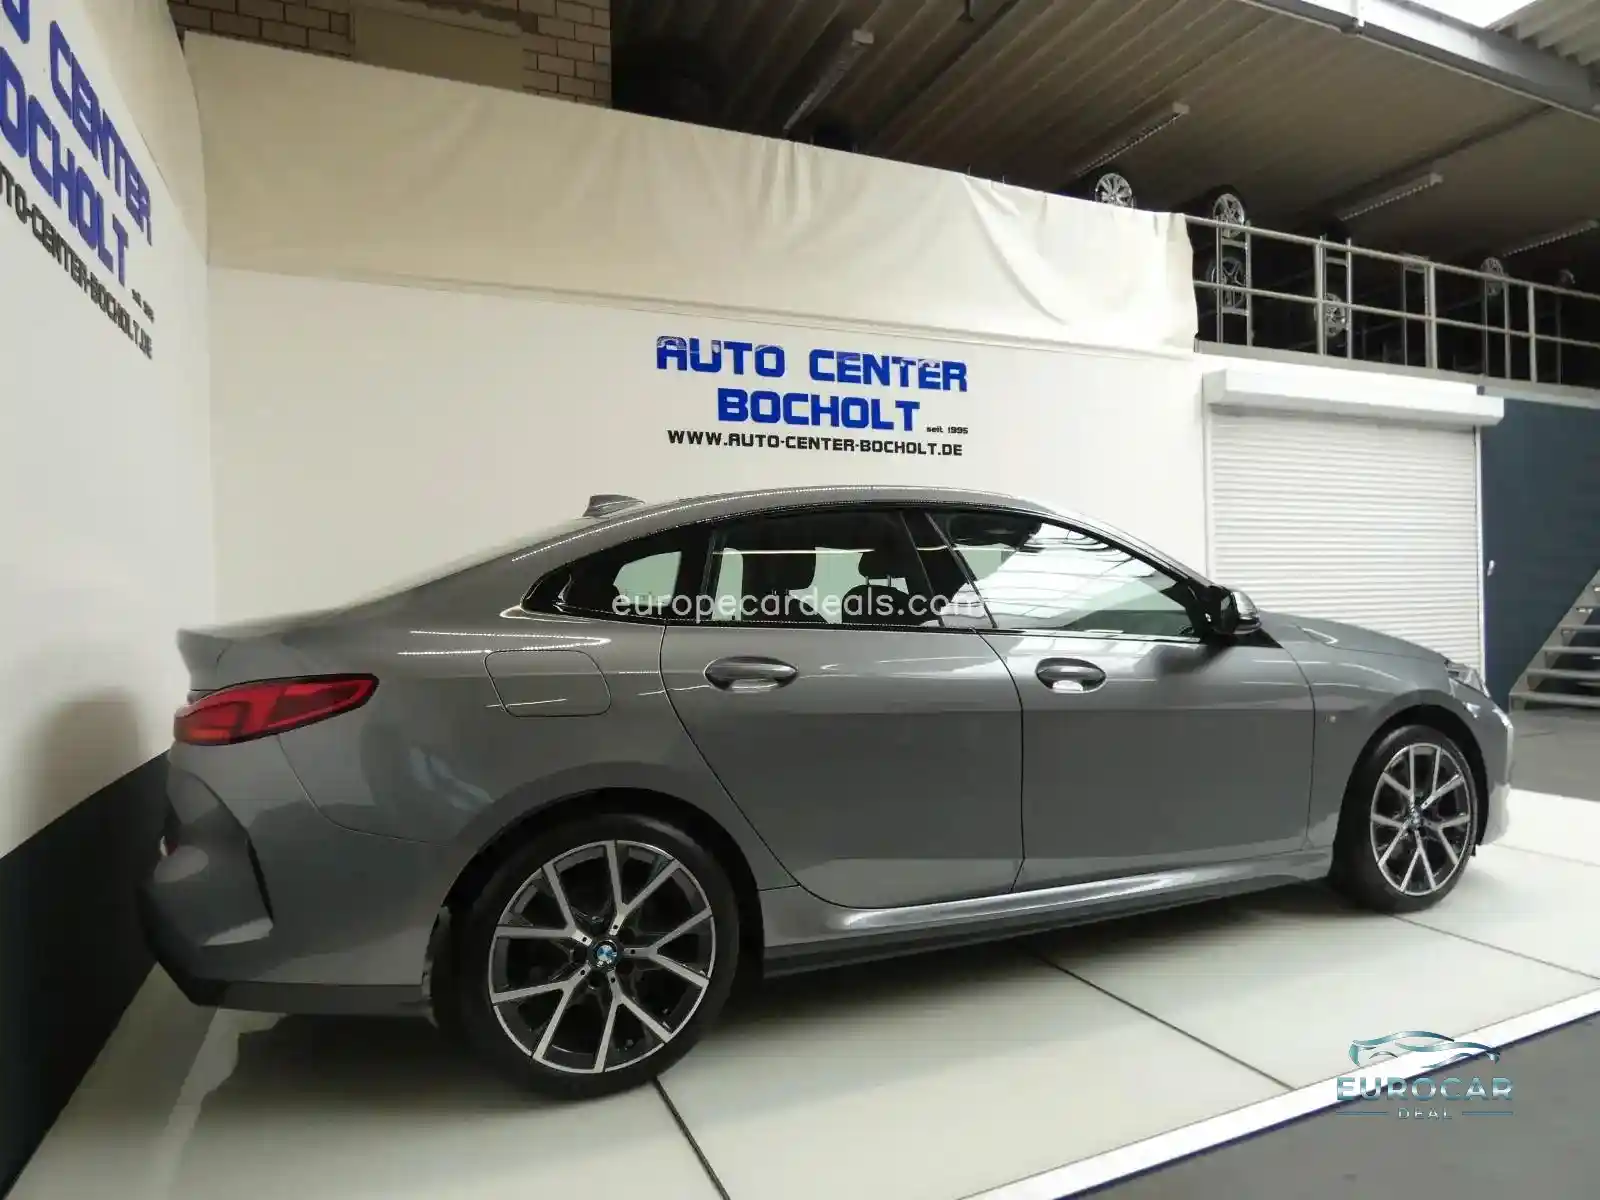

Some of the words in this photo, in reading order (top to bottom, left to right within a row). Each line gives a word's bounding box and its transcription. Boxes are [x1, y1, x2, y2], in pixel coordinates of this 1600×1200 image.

[50, 20, 152, 247] CENTER
[0, 160, 152, 360] TO-CENTER-BOCHOLT.DE
[656, 335, 785, 378] AUTO
[808, 348, 968, 392] CENTER
[717, 387, 921, 432] BOCHOLT
[926, 425, 944, 433] seit
[947, 426, 969, 435] 1995
[667, 429, 963, 456] WWW.AUTO-CENTER-BOCHOLT.DE
